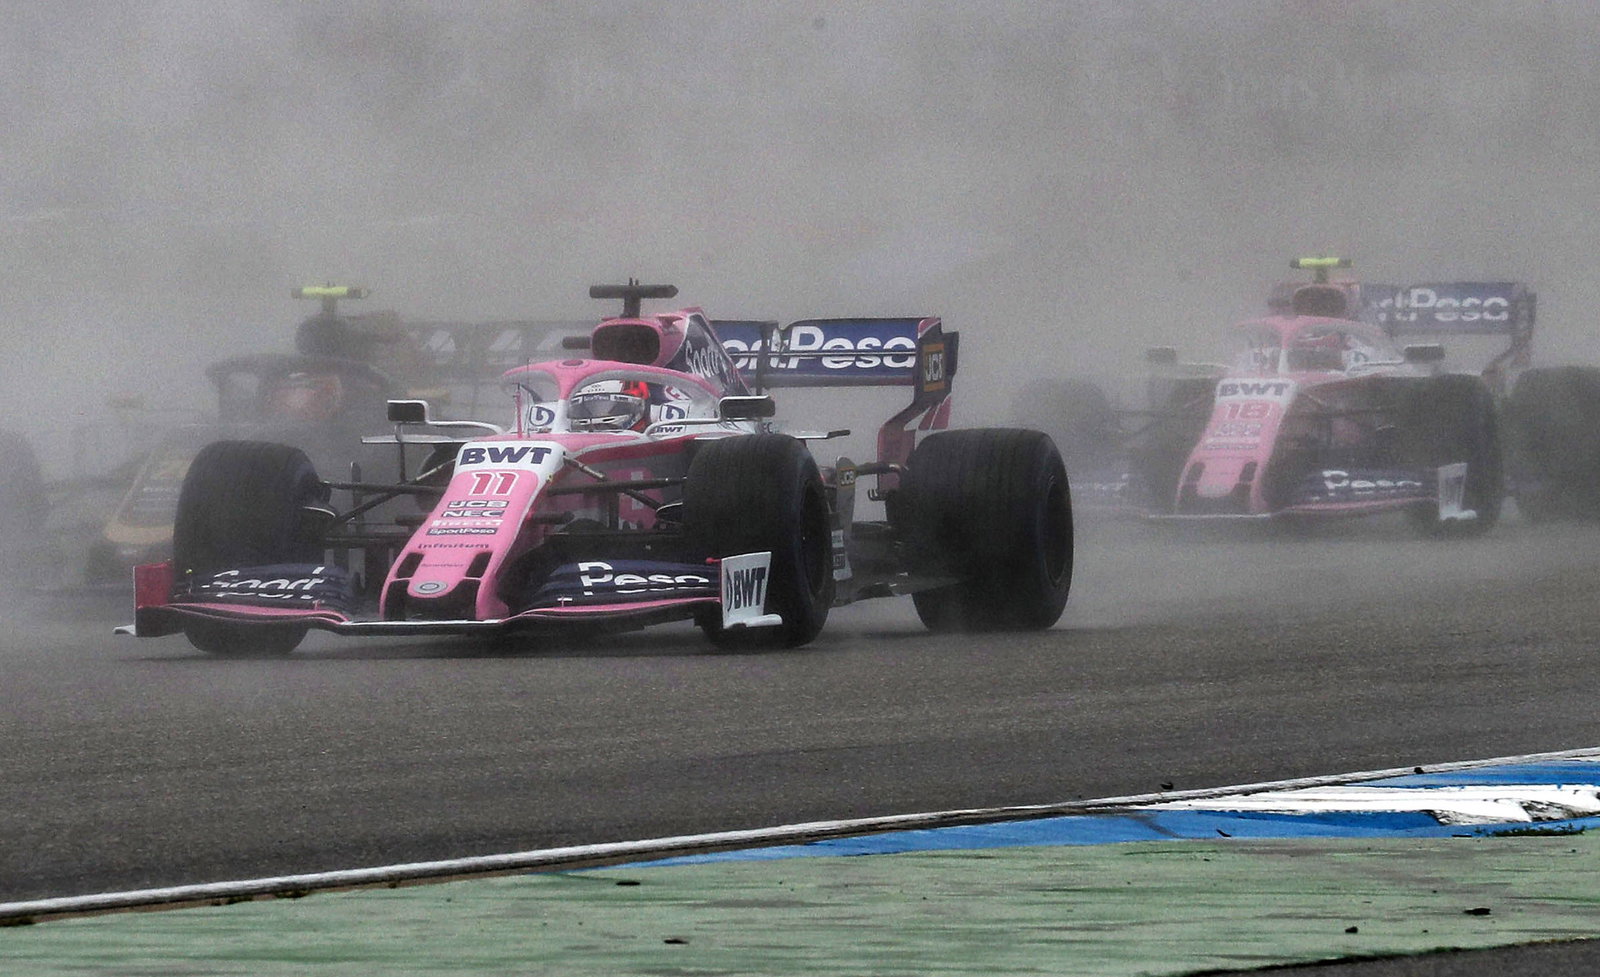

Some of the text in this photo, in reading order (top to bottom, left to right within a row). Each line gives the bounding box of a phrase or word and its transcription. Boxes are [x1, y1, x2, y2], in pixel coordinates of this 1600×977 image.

[1219, 383, 1290, 396] BWT
[460, 447, 551, 466] BWT
[469, 471, 520, 496] 11
[448, 500, 509, 508] JCB
[578, 561, 710, 597] Pesa
[733, 567, 767, 610] BWT
